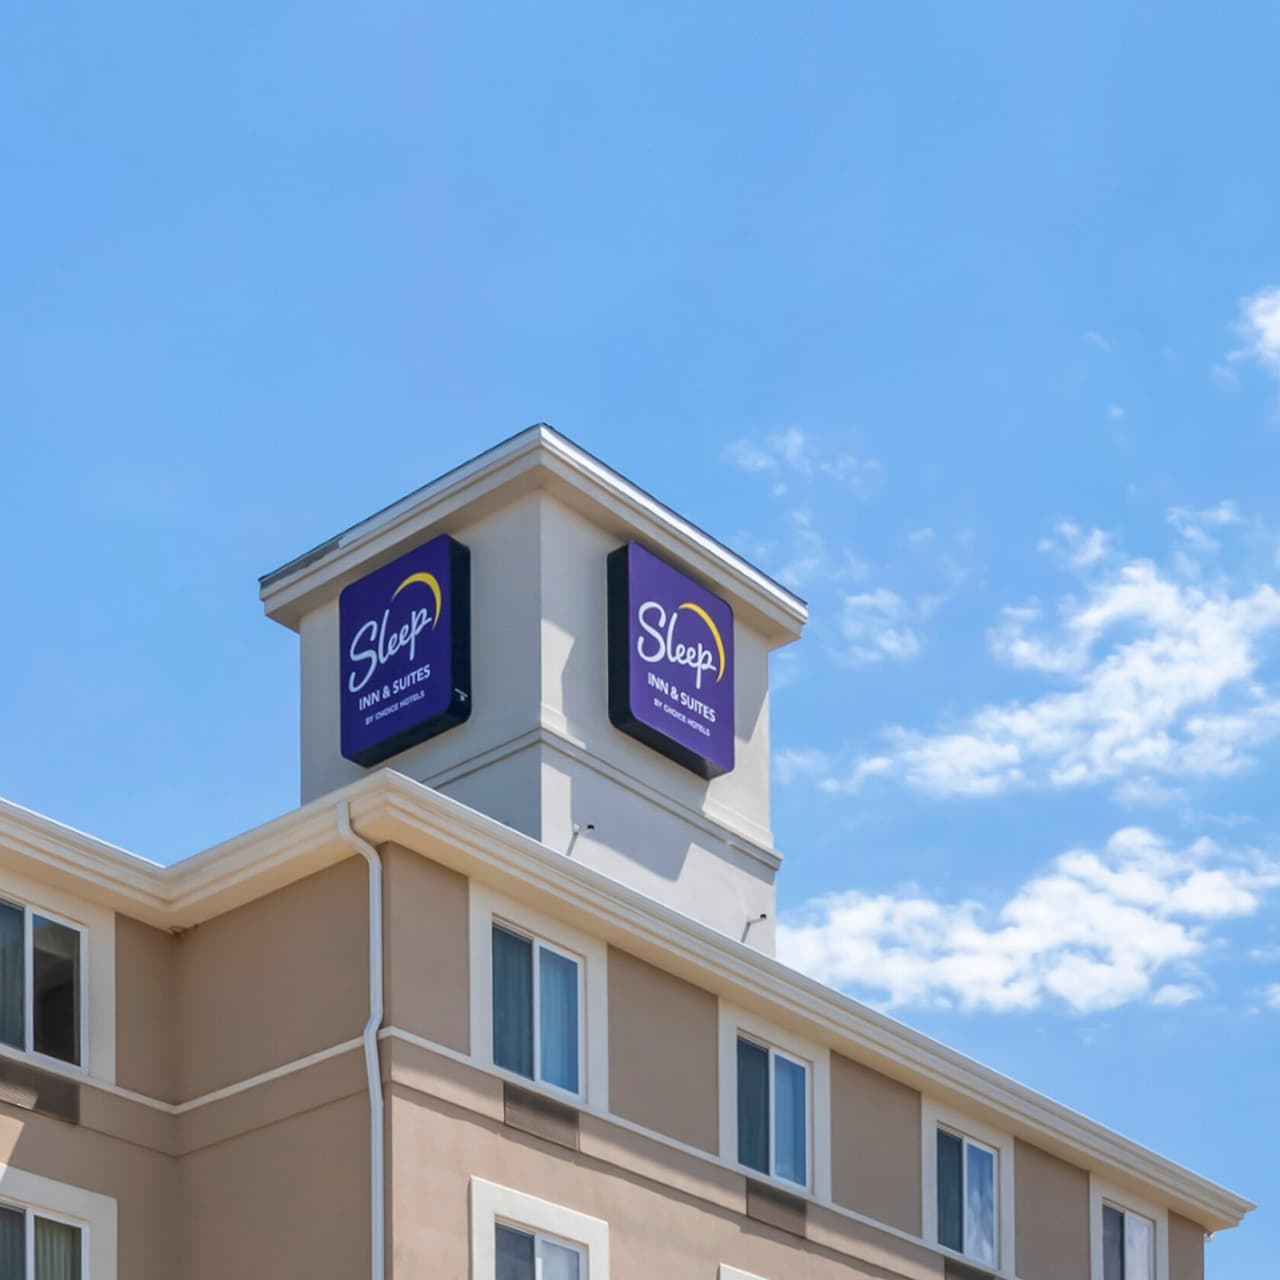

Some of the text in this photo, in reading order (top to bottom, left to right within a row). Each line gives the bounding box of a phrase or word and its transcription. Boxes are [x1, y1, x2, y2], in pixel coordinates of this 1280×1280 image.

[348, 607, 433, 693] Sleep
[637, 601, 717, 689] Sleep
[359, 663, 431, 711] INN & SUITES
[365, 689, 425, 726] BY CHOICE HOTELS
[647, 671, 716, 723] INN & SUITES
[653, 697, 711, 737] BY CHOICE HOTELS
